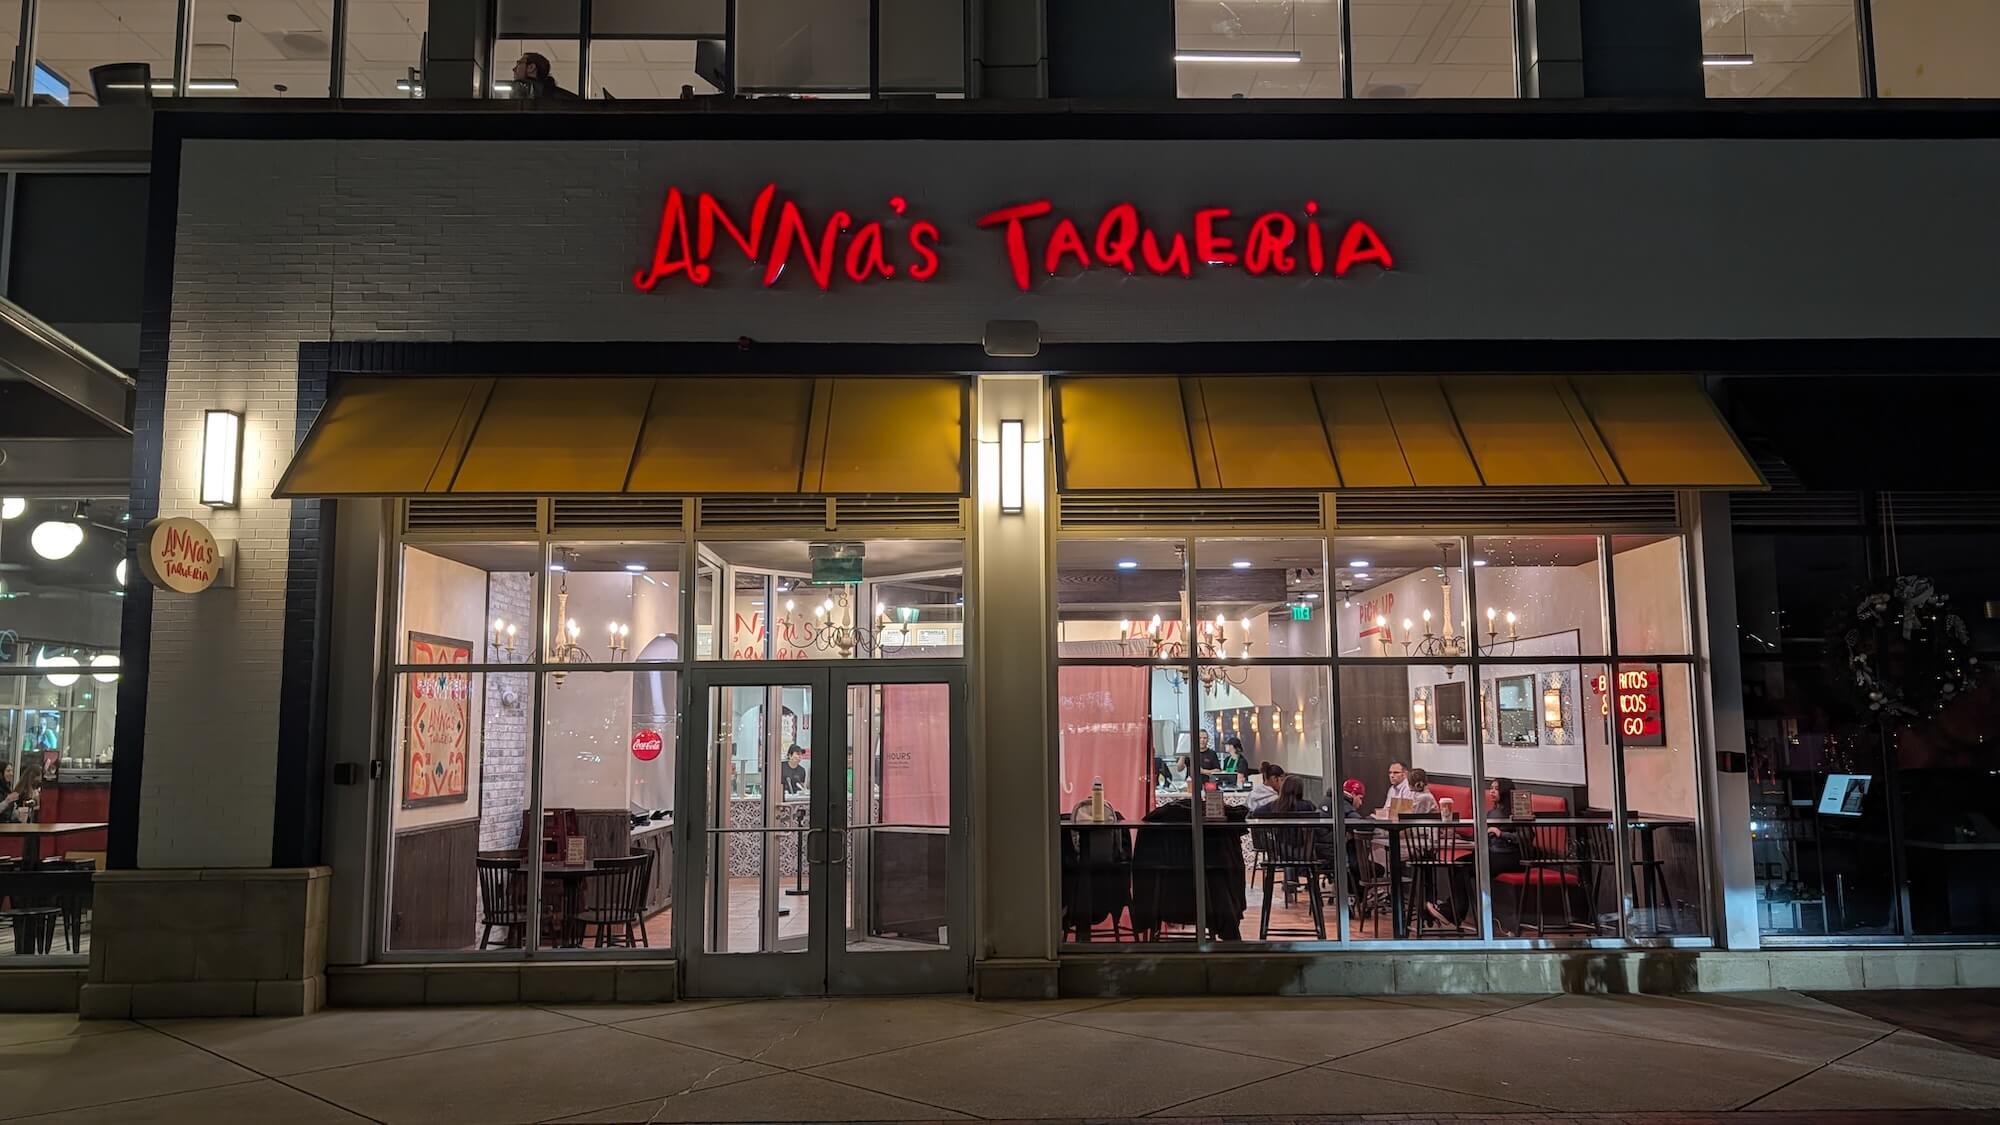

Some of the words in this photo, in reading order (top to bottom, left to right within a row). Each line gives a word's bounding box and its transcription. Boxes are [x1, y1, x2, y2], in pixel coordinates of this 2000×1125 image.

[1598, 671, 1648, 692] BRITOS
[1623, 717, 1644, 736] GO
[886, 751, 912, 760] HOURS
